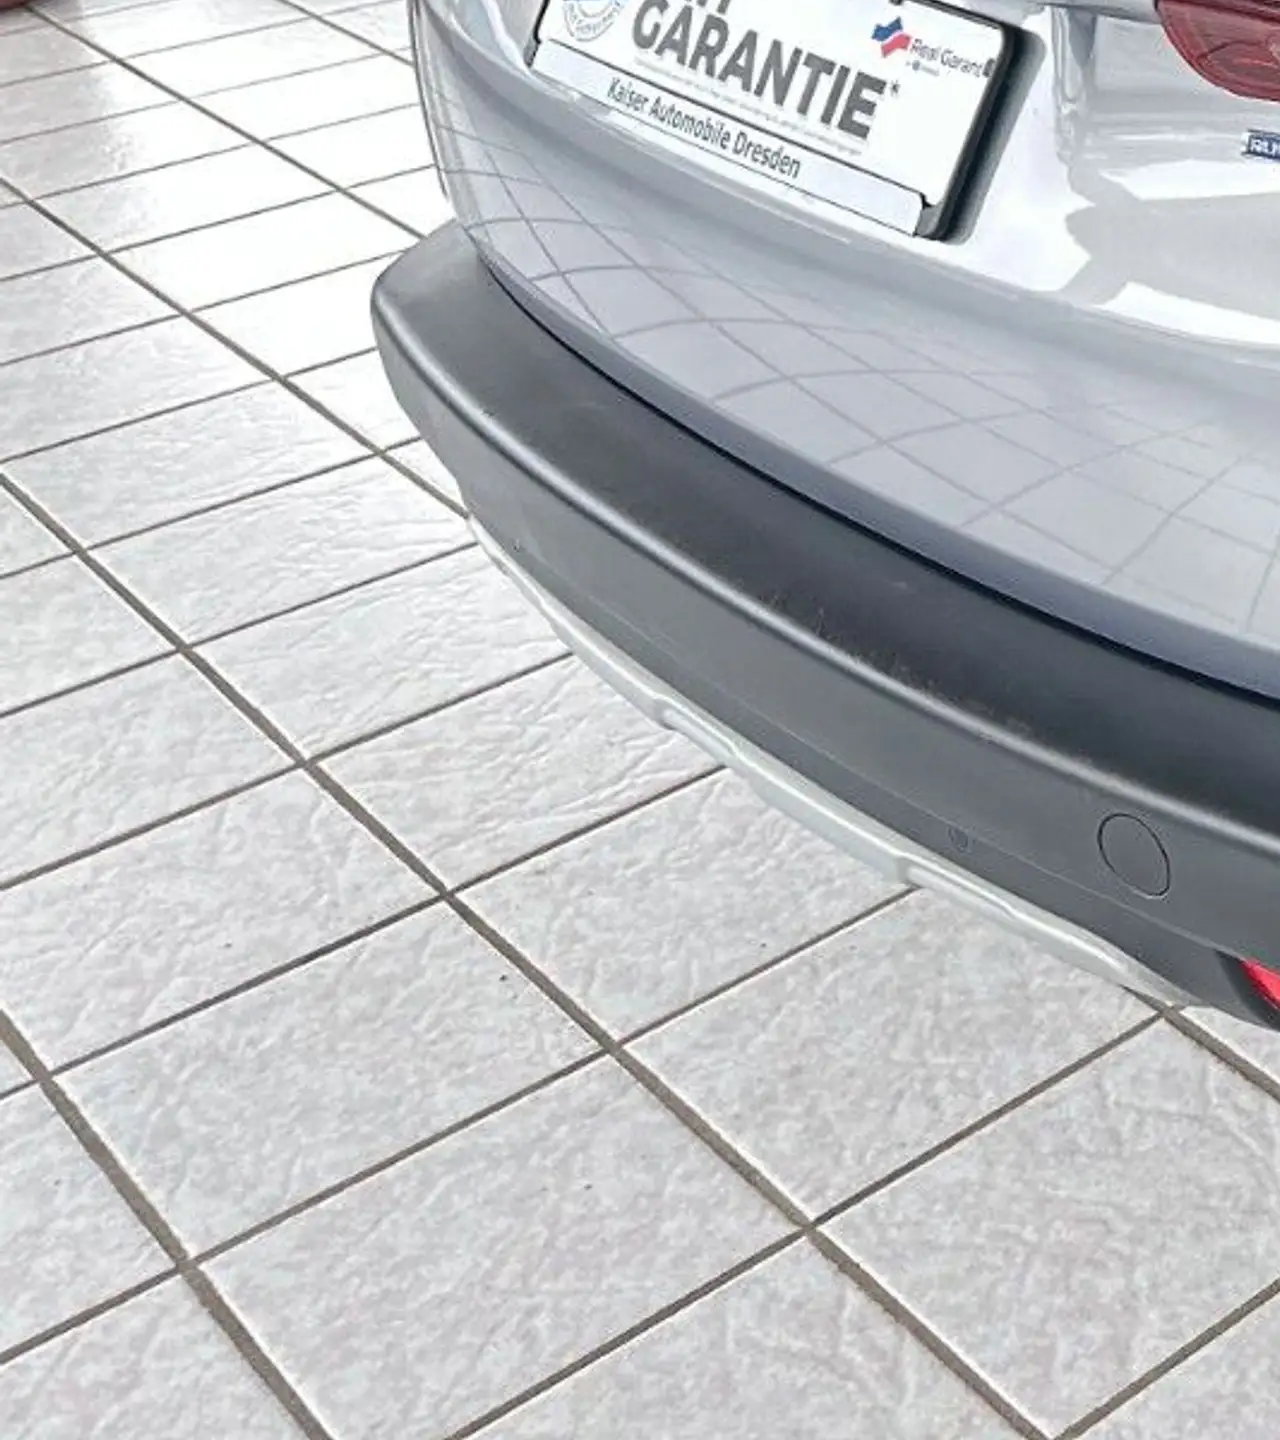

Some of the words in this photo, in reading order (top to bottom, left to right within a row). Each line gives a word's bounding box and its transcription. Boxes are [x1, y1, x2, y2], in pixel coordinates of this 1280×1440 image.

[607, 77, 650, 117] Kaiser
[649, 96, 732, 149] Automobile
[733, 132, 800, 178] Dresden
